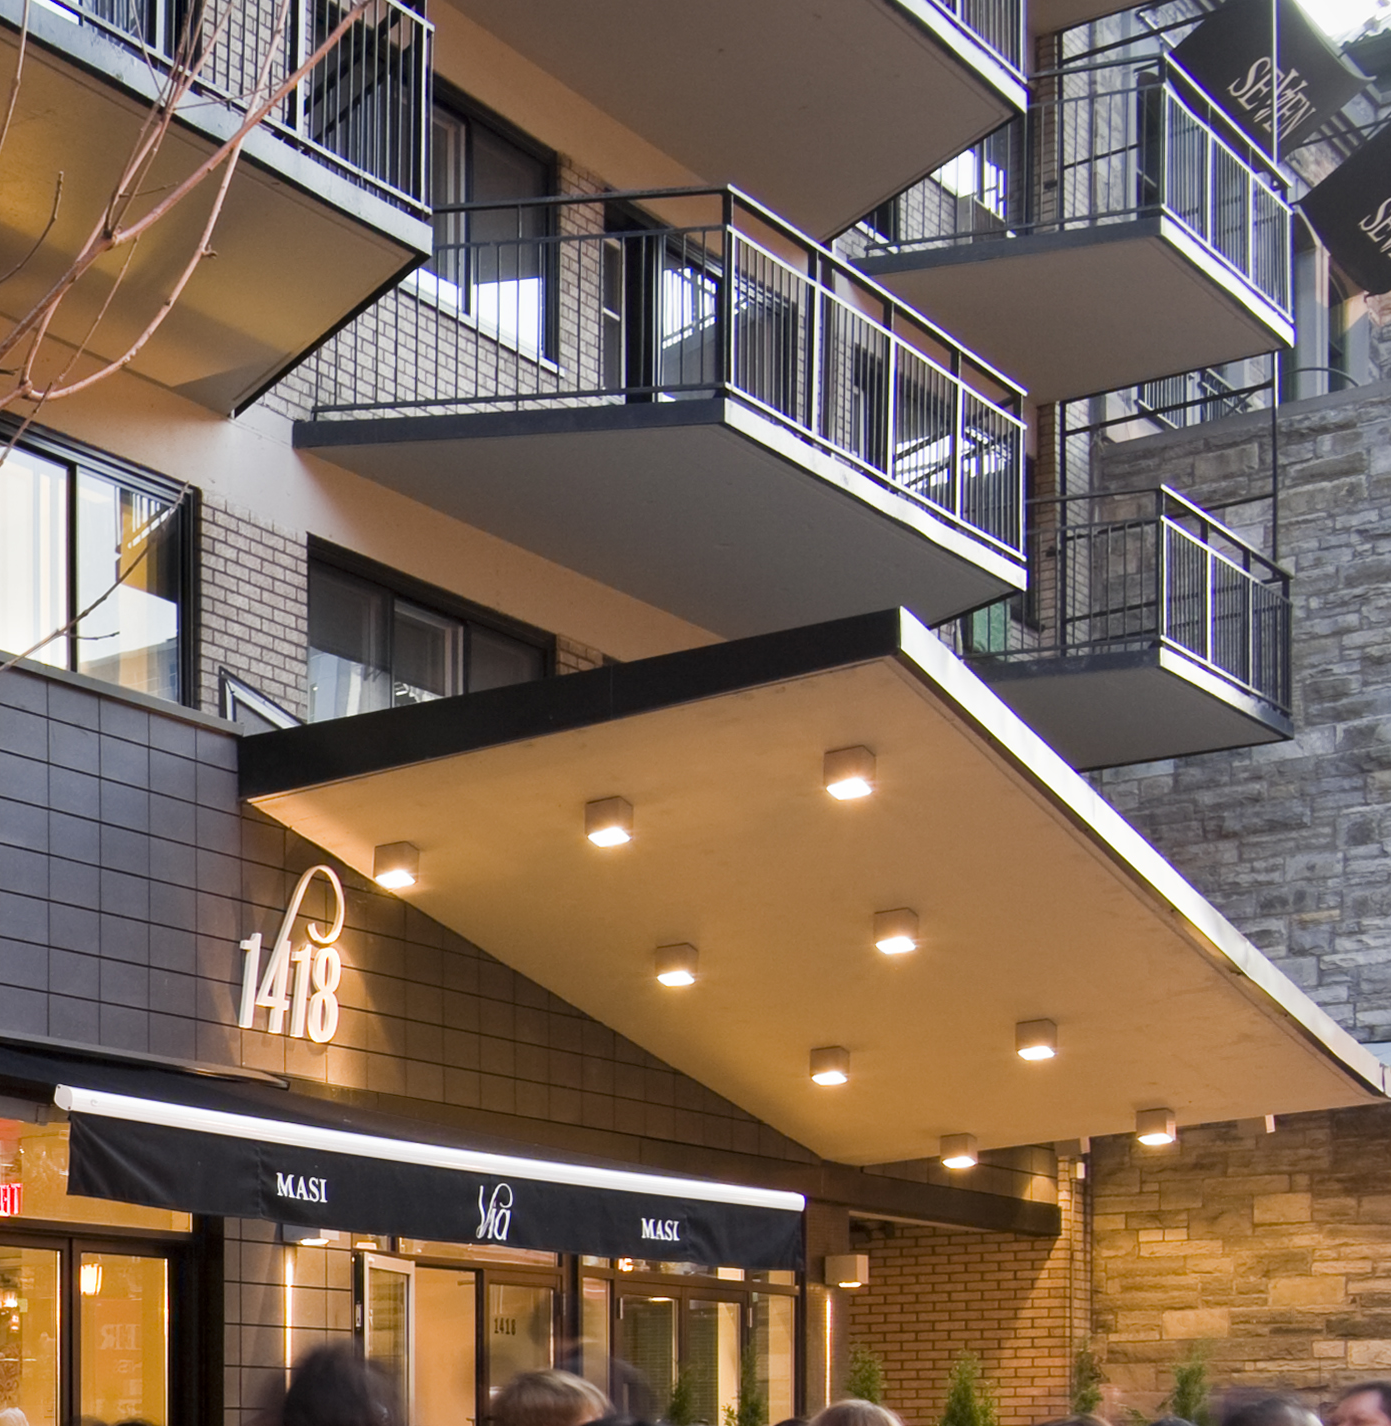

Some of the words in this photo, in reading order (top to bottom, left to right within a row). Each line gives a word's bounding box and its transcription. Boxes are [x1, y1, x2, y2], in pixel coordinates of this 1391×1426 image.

[1225, 56, 1316, 141] SEVEN
[238, 865, 345, 1043] 1418
[276, 1172, 328, 1203] MASI
[475, 1183, 513, 1240] Via
[641, 1217, 680, 1241] MASI
[494, 1317, 516, 1336] 1418
